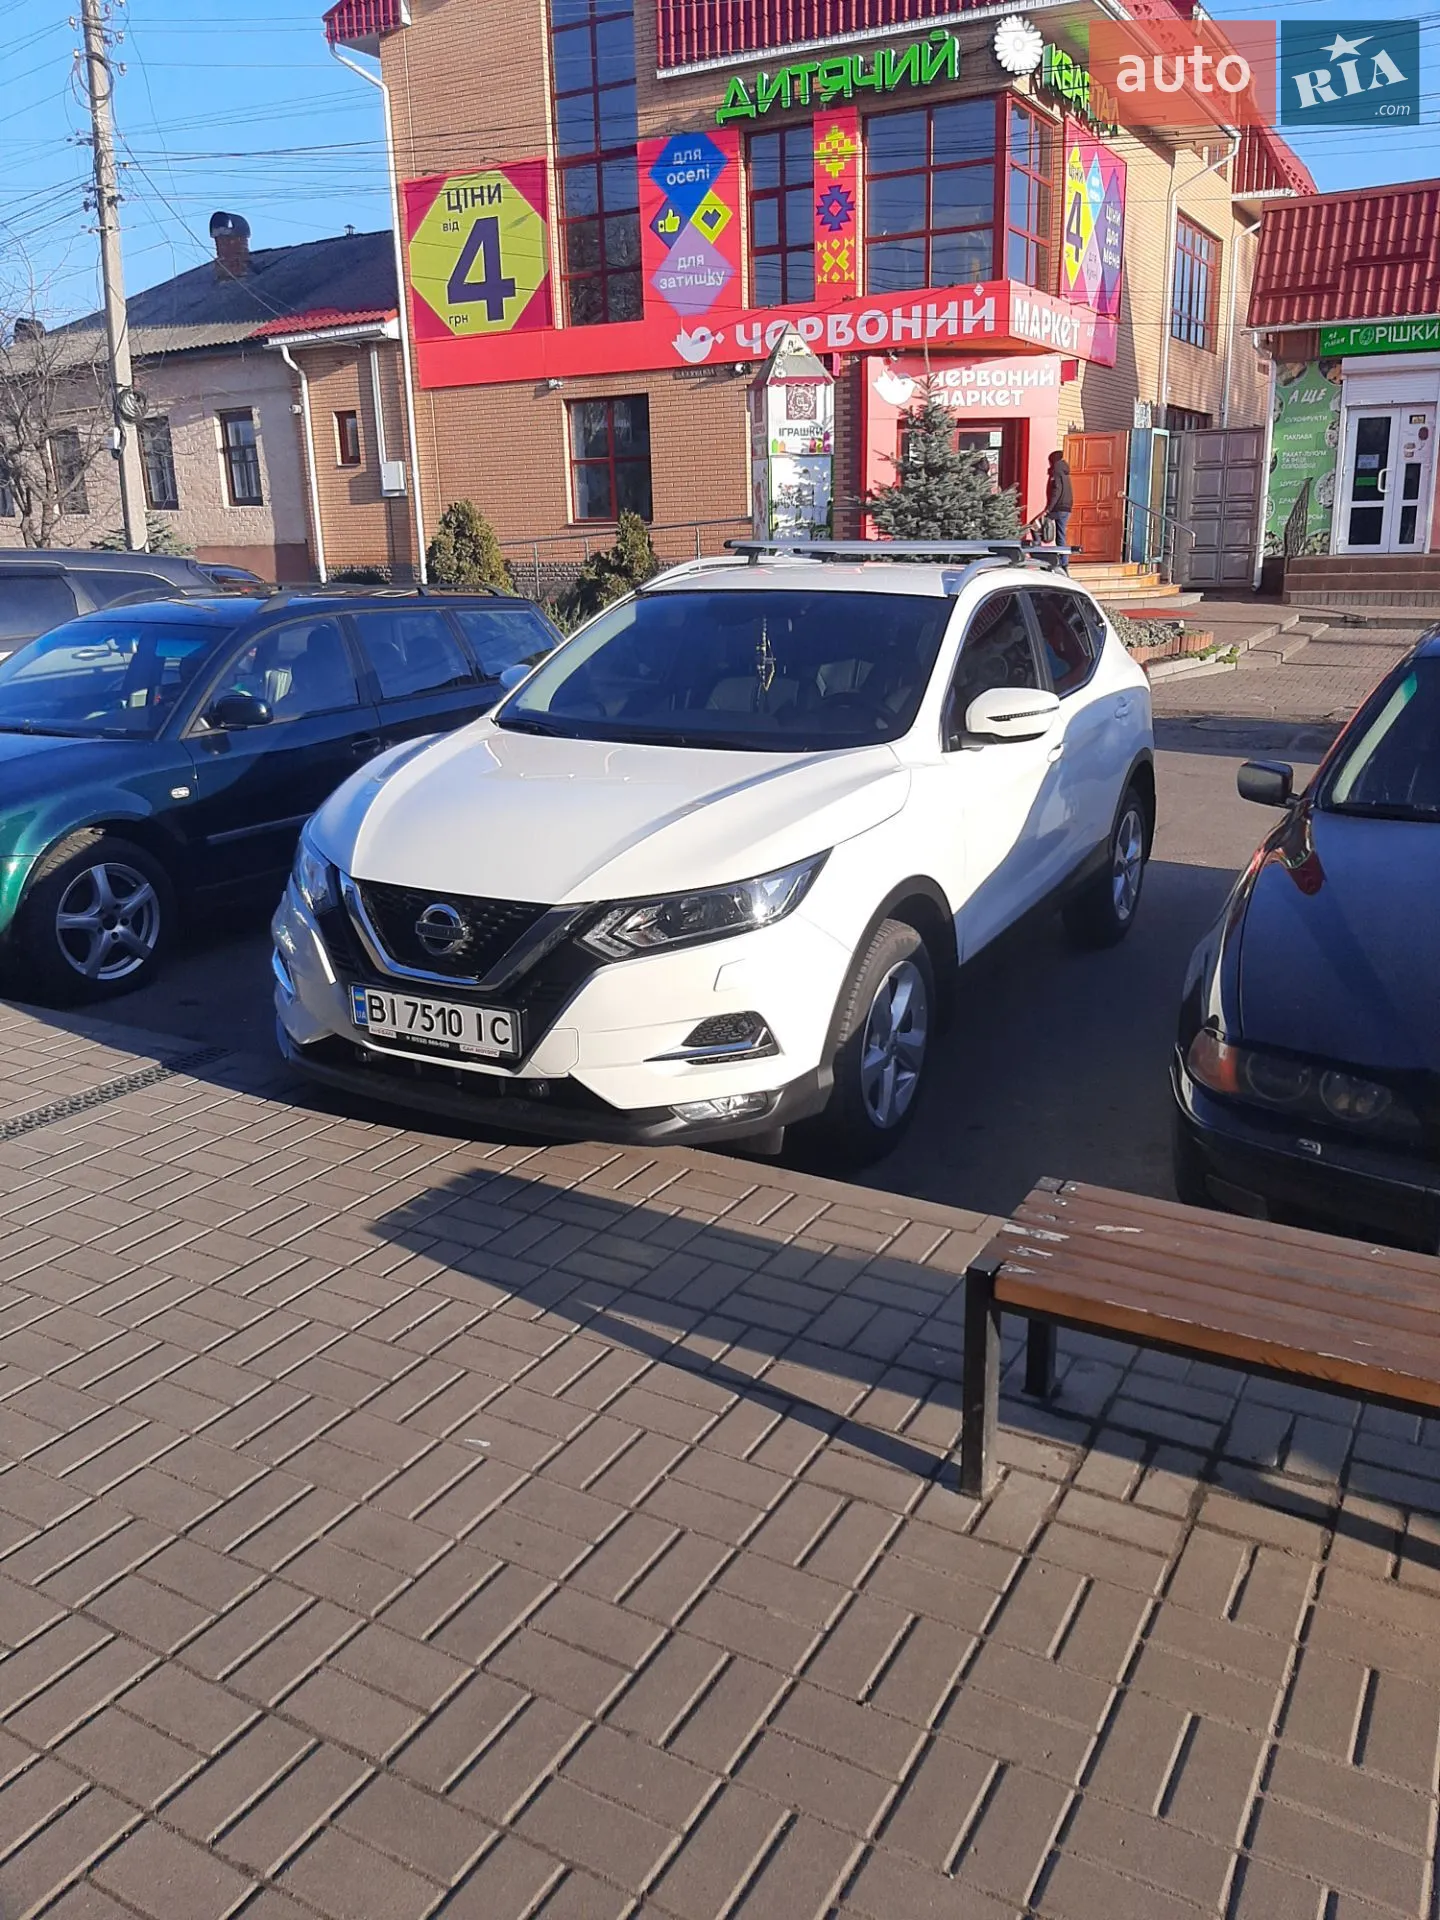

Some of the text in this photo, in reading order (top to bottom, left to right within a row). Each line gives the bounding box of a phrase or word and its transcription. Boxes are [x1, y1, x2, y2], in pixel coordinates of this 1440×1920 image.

[716, 30, 961, 125] ДИТЯЧИЙ
[673, 148, 702, 165] для
[666, 164, 710, 186] оселі
[442, 218, 460, 233] від
[1066, 191, 1083, 263] 4
[447, 216, 516, 322] 4
[676, 254, 705, 270] для
[659, 269, 725, 290] затишку
[448, 313, 469, 328] грн
[1014, 296, 1081, 351] МАРКЕТ
[1350, 323, 1440, 346] ГОРІШКИ
[778, 427, 824, 437] ІГРАШКИ
[356, 1010, 367, 1020] UA
[367, 994, 510, 1045] BI 7510 IC
